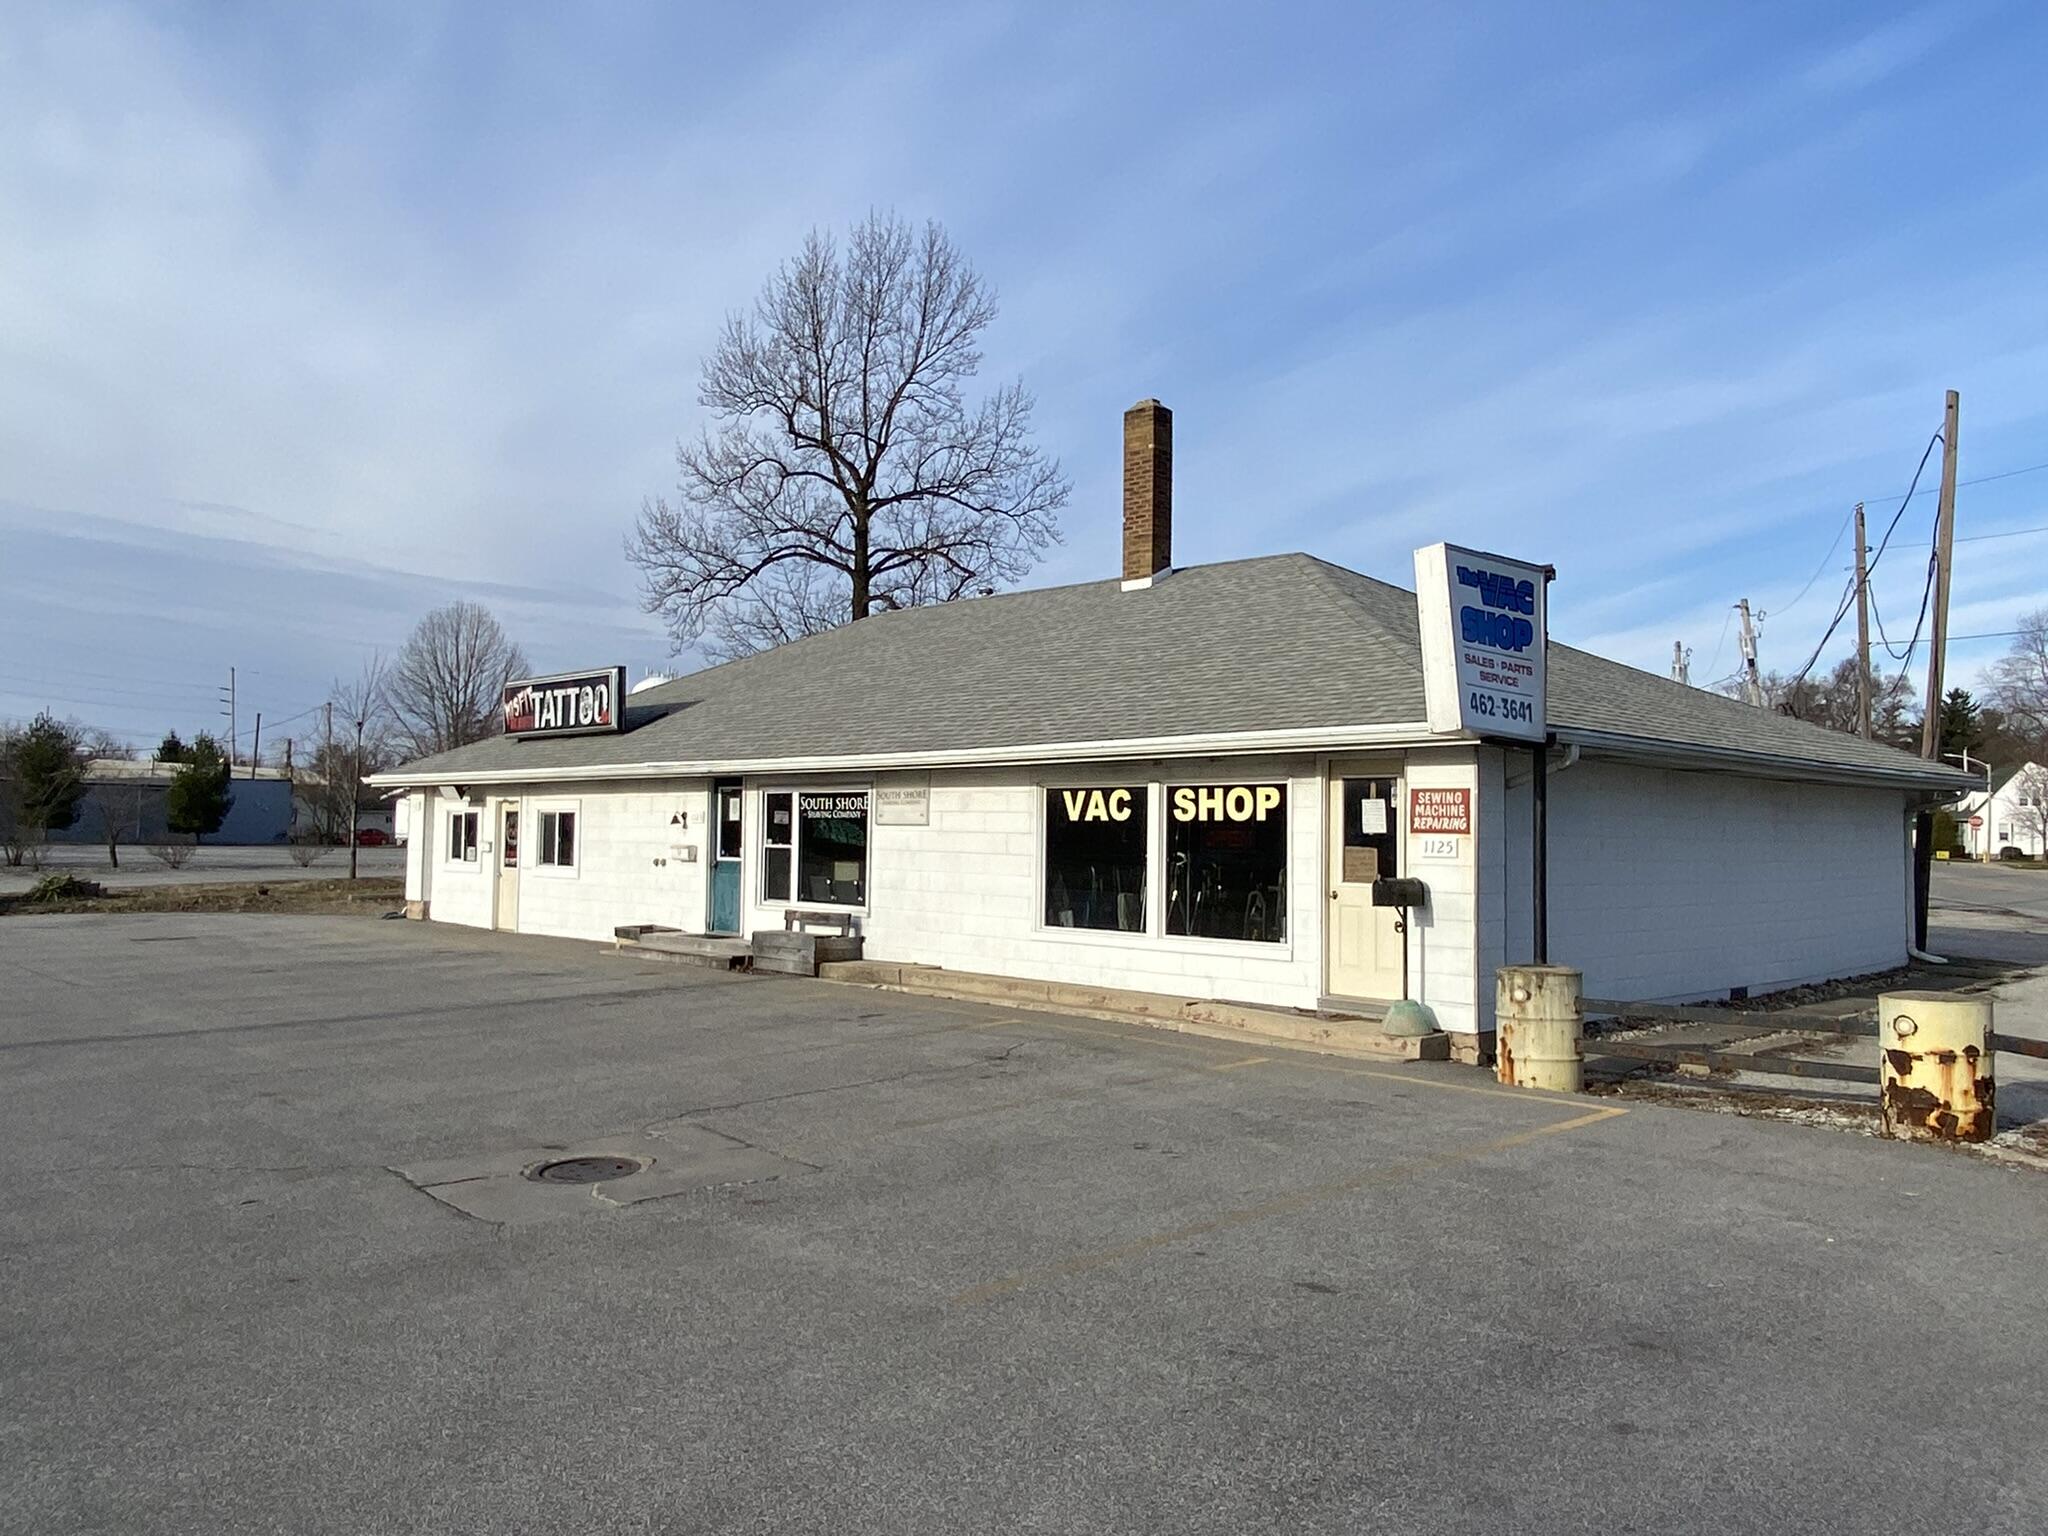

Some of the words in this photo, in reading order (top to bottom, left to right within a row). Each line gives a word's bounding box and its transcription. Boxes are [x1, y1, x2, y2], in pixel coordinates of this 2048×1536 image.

[1478, 569, 1534, 616] VAC
[1461, 606, 1533, 653] SHOP
[1464, 653, 1495, 669] SALES
[1501, 661, 1533, 676] PARTS
[1479, 670, 1519, 688] SERVICE
[532, 684, 608, 728] TATTOO
[1470, 692, 1533, 724] 462-3641
[800, 796, 834, 810] SOUTH
[836, 796, 869, 810] SHORE
[876, 790, 901, 800] SOUTH
[903, 789, 927, 800] SHORE
[1417, 791, 1463, 804] SEWING
[1062, 788, 1132, 822] VAC
[1173, 787, 1281, 822] SHOP
[1415, 804, 1466, 817] MACHINE
[1413, 817, 1468, 831] REPAIRING
[1423, 840, 1454, 855] 1125
